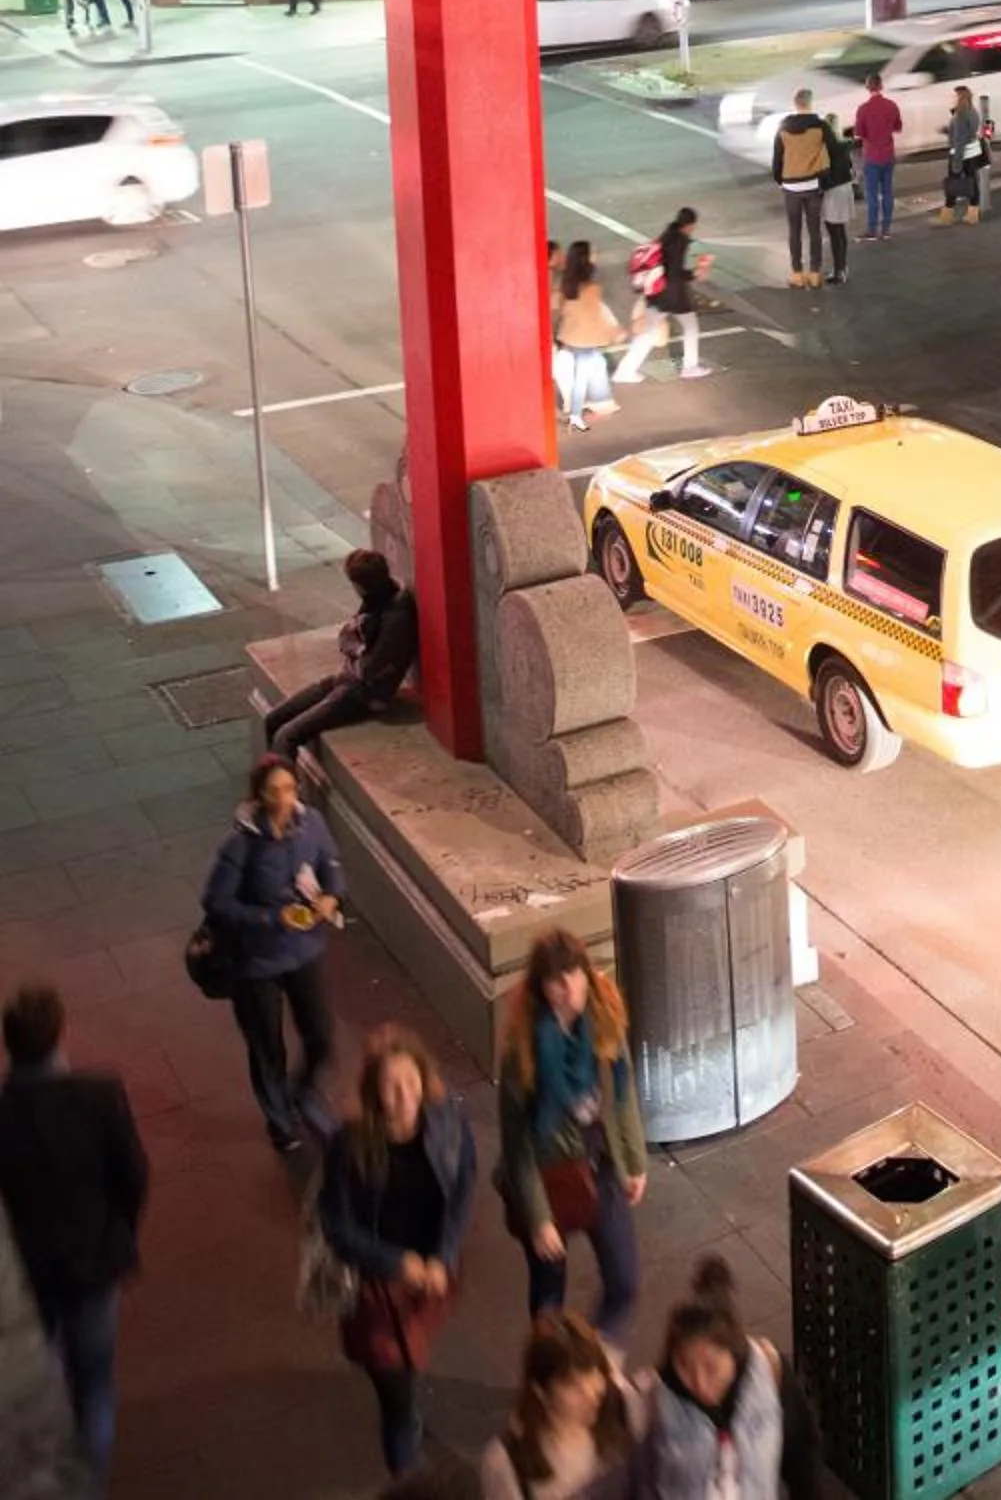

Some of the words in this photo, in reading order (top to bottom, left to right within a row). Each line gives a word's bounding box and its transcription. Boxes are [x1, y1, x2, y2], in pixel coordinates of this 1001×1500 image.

[829, 400, 855, 414] TAXI
[661, 526, 678, 555] 131
[680, 538, 703, 568] 008
[752, 594, 785, 628] 3925
